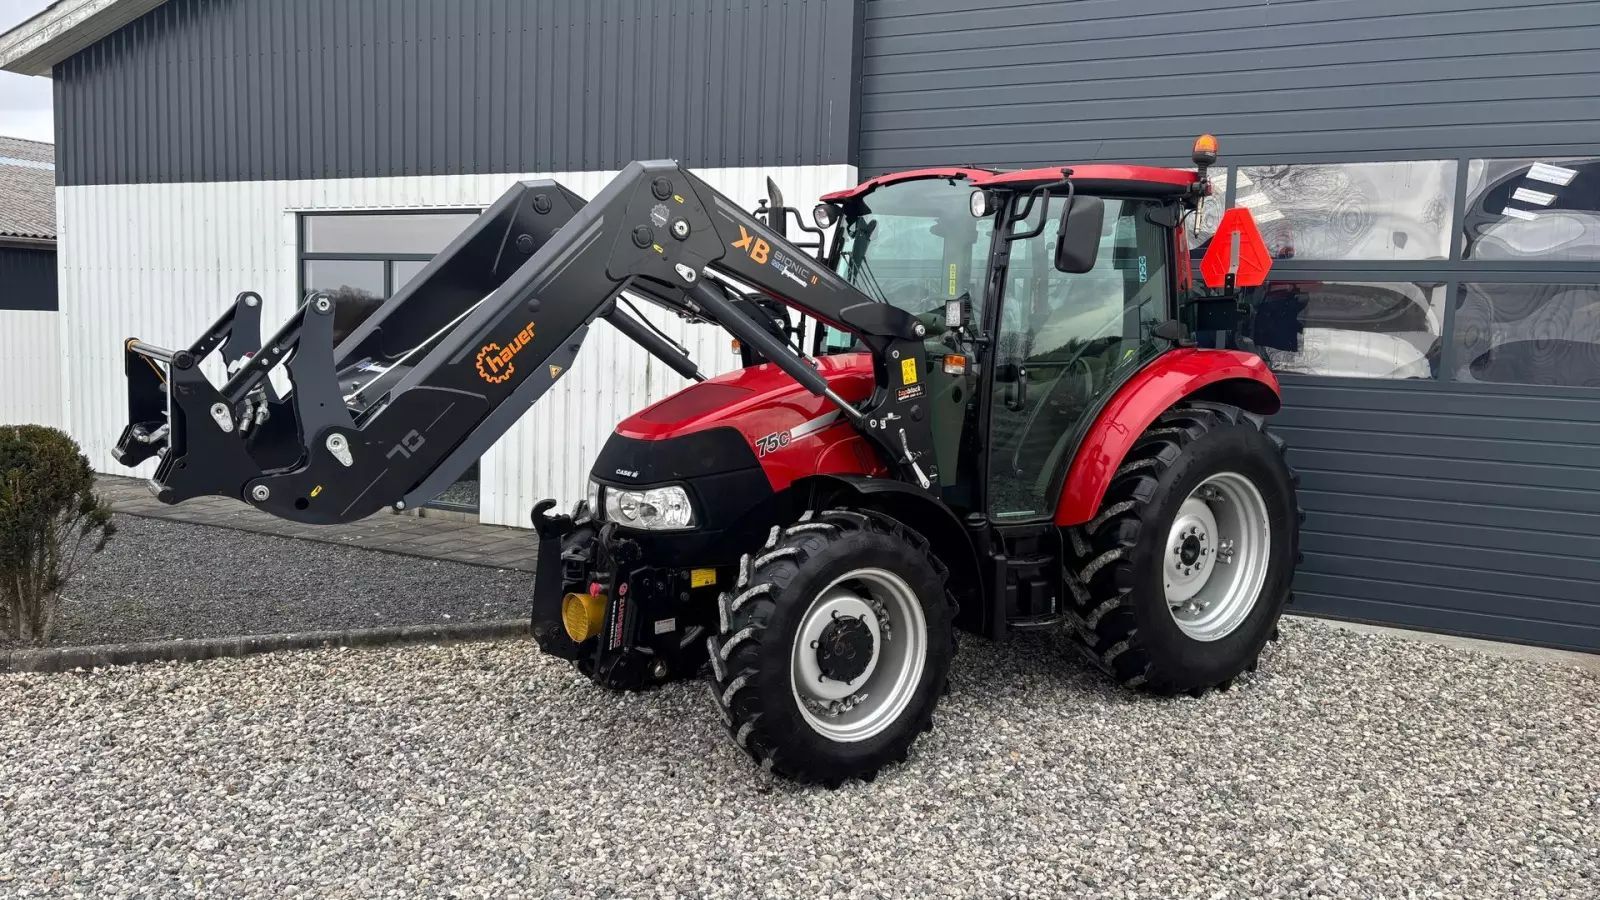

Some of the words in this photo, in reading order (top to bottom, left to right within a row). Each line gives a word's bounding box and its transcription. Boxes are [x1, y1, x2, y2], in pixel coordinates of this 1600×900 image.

[774, 250, 809, 279] BIONIC
[485, 321, 535, 374] hauer
[386, 428, 426, 460] 70
[755, 431, 791, 458] 75C
[615, 468, 632, 477] CASE
